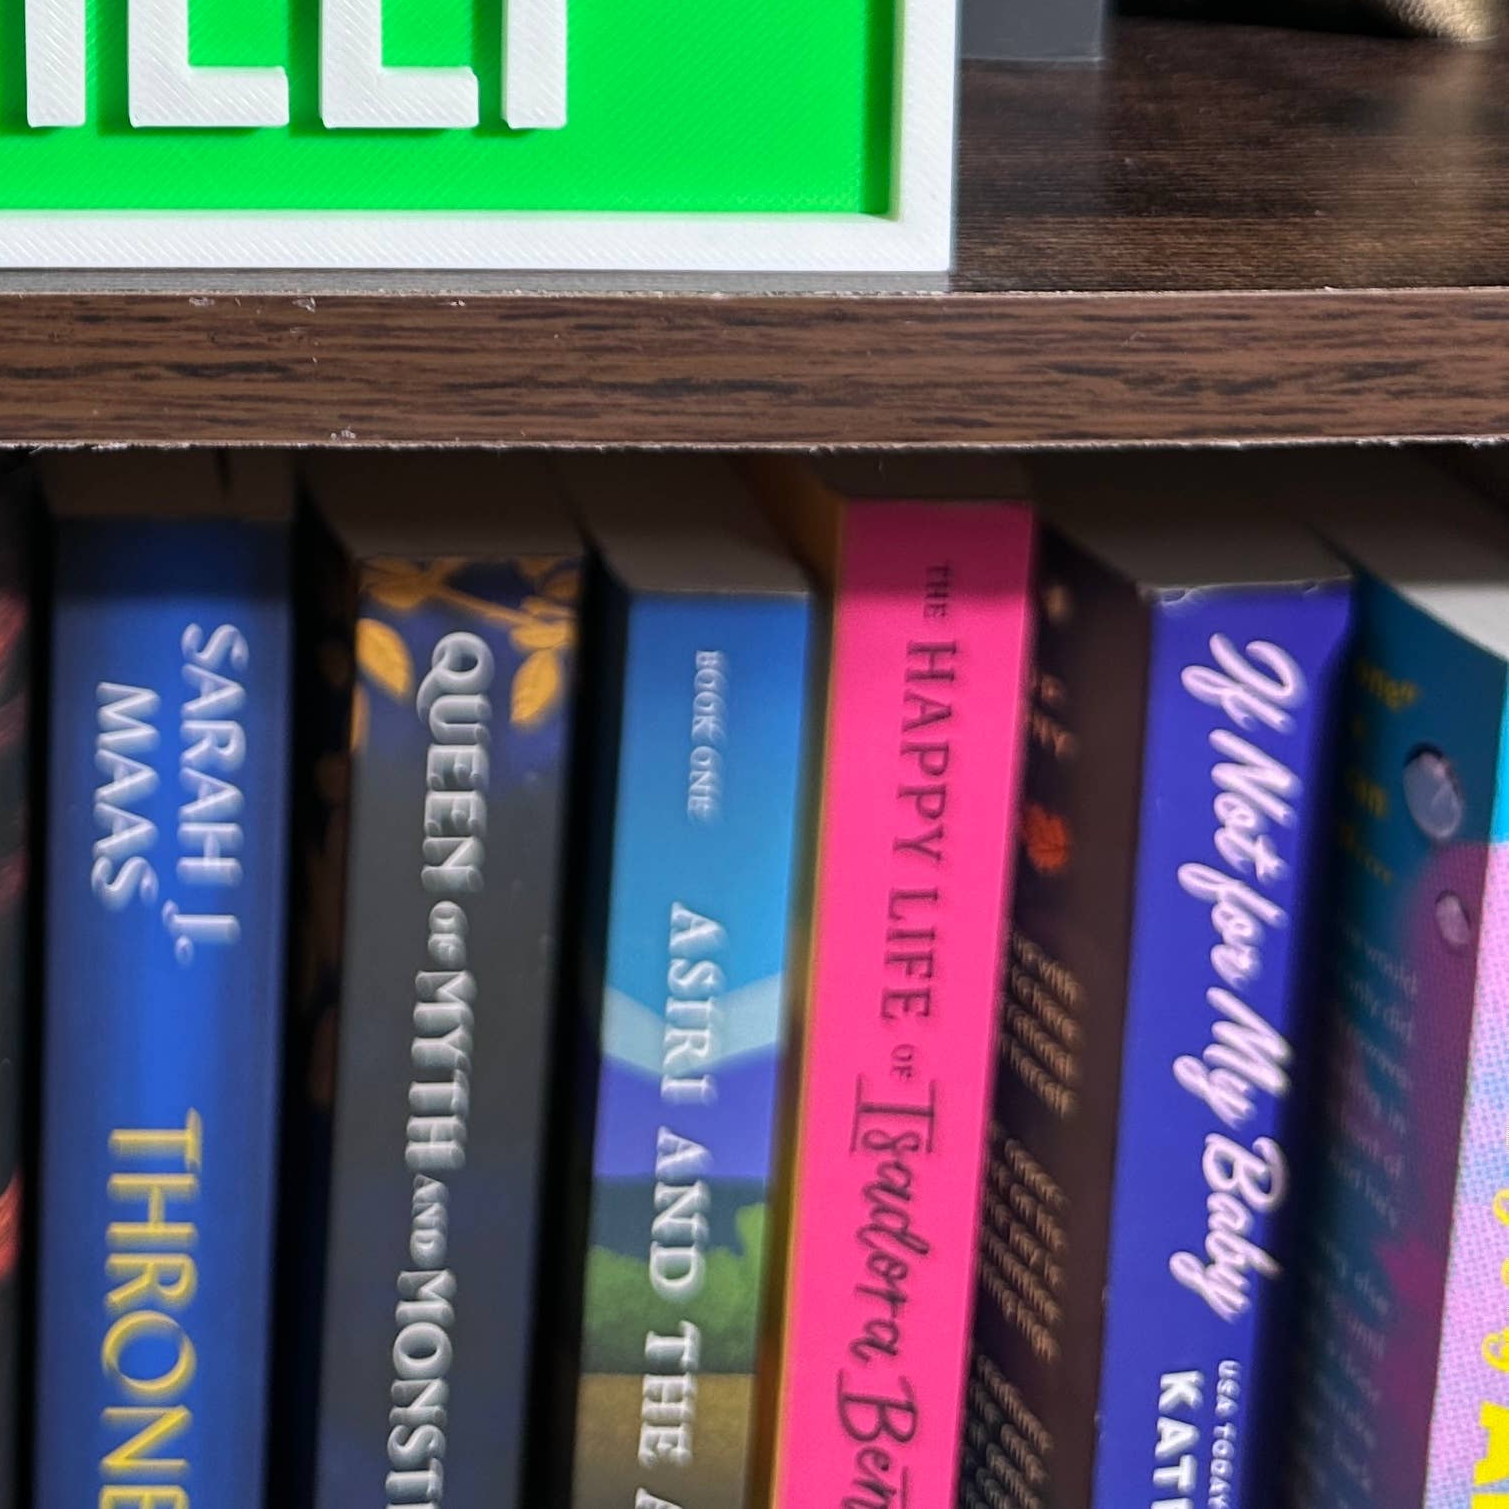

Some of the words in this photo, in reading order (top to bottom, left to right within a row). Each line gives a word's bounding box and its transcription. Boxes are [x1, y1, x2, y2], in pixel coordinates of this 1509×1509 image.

[923, 563, 954, 621] THE
[177, 623, 248, 887] SARAH
[417, 632, 494, 892] QUEEN
[692, 650, 728, 747] BOOK
[892, 639, 958, 862] HAPPY
[92, 681, 161, 912] MAAS
[687, 746, 724, 822] ONE
[1209, 729, 1302, 886] Not
[162, 900, 241, 966] J.
[428, 901, 468, 967] OF
[879, 888, 940, 1022] LIFE
[1178, 862, 1289, 986] for
[405, 971, 477, 1172] MYTH
[660, 901, 726, 1106] ASIRI
[890, 1043, 916, 1082] OF
[1172, 987, 1293, 1130] My
[410, 1174, 448, 1270] AND
[649, 1126, 712, 1302] AND
[850, 1074, 935, 1363] Isadora
[1169, 1133, 1287, 1325] Baby
[386, 1269, 457, 1509] MONST
[637, 1321, 701, 1468] THE
[836, 1368, 920, 1509] Ben
[1214, 1359, 1241, 1418] USA
